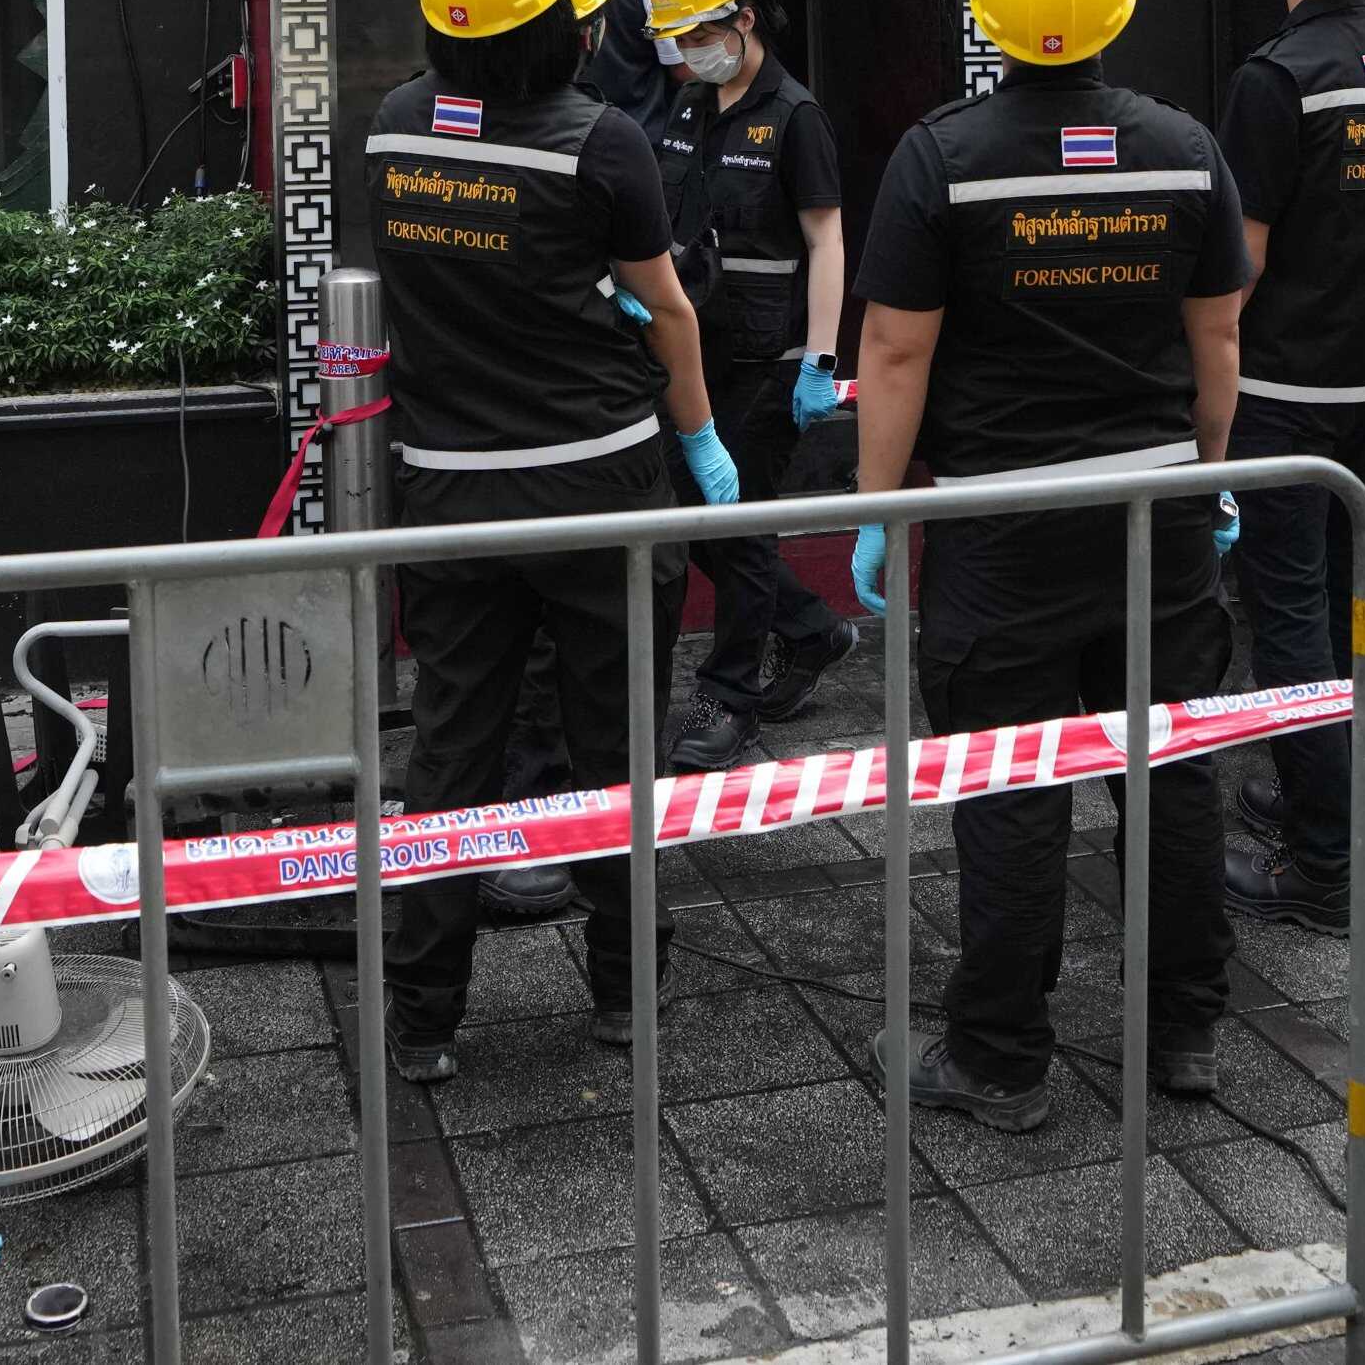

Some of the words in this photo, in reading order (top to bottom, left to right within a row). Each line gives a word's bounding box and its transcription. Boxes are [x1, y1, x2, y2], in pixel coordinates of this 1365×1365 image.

[386, 166, 518, 204] พิสูจน์หลักฐานตำรวจ
[387, 220, 452, 245] FORENSIC
[453, 228, 510, 251] POLICE
[1011, 207, 1168, 246] พิสูจน์หลักฐานตำรวจ
[1013, 266, 1100, 287] FORENSIC
[1100, 263, 1161, 284] POLICE
[278, 839, 450, 886] DANGROUS
[456, 828, 531, 862] AREA
